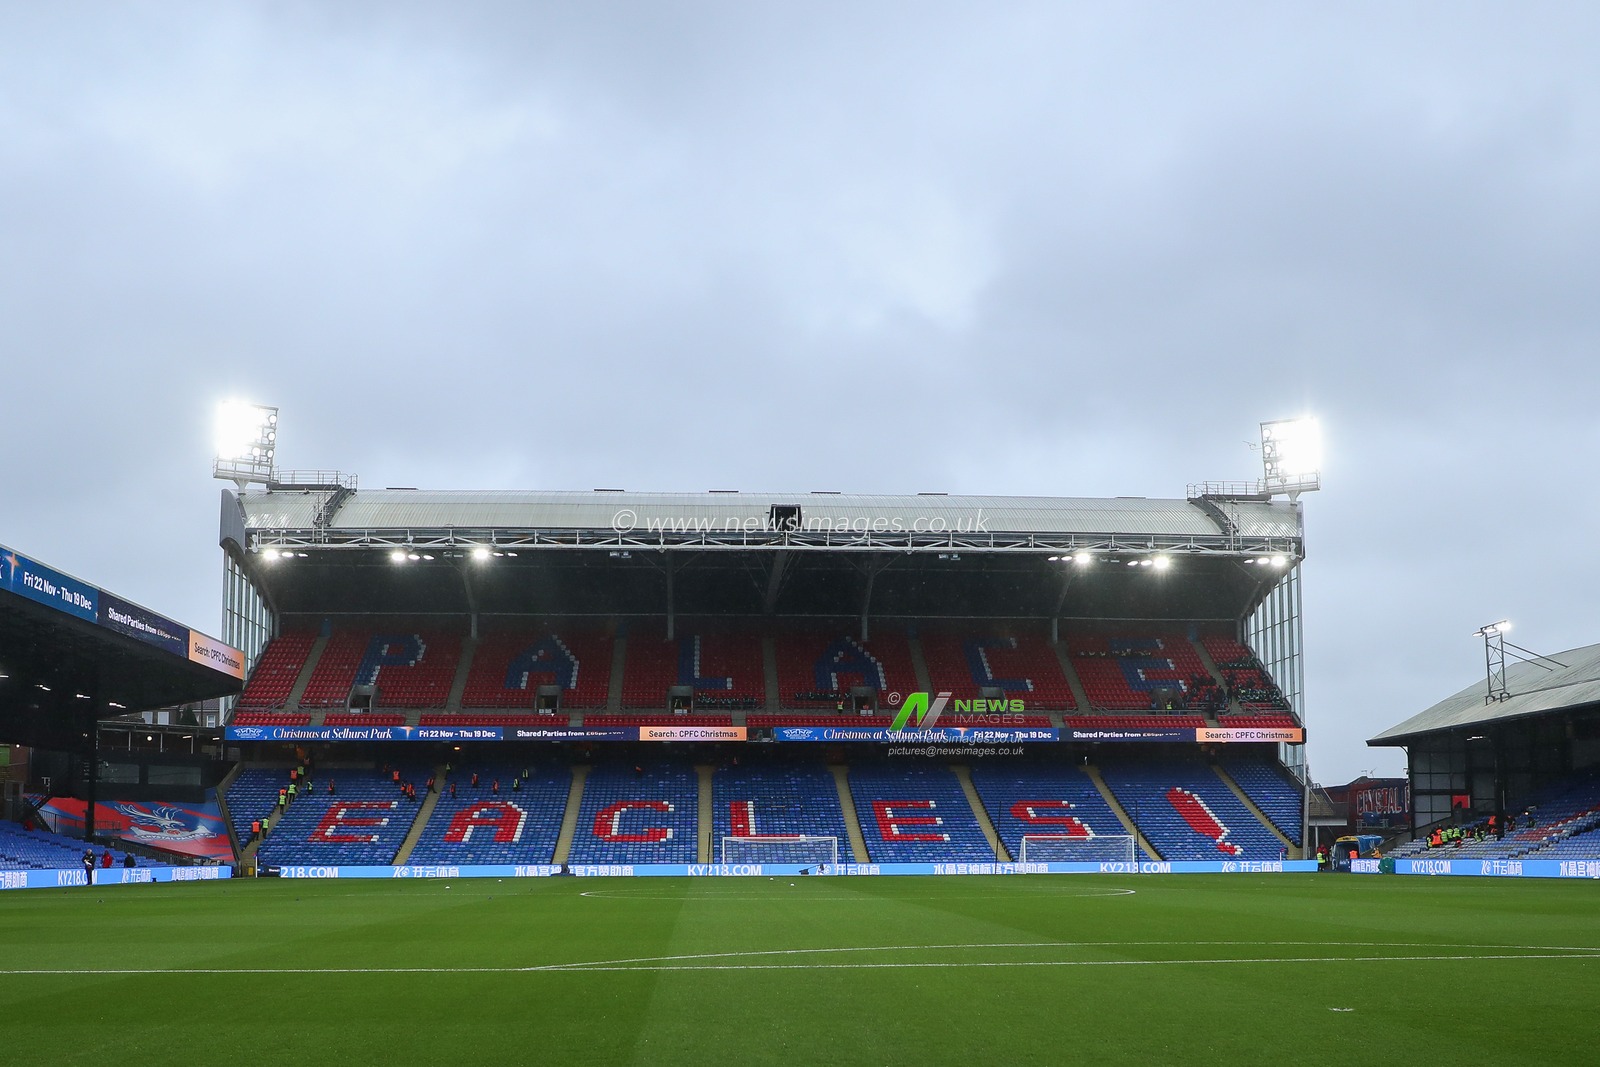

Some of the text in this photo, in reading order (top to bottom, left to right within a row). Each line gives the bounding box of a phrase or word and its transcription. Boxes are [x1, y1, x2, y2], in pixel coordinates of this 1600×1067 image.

[24, 571, 34, 587] Fri
[34, 576, 43, 591] 22
[43, 579, 56, 596] Nov
[61, 586, 73, 603] Thu
[73, 592, 80, 606] 19
[80, 595, 92, 610] Dec
[108, 607, 127, 625] Shared
[127, 615, 145, 630] Parties
[145, 623, 157, 635] from
[194, 642, 241, 670] Search: CPFC Christmas
[273, 728, 392, 739] Christmas at Selhurst Park
[419, 730, 429, 738] Fri
[429, 730, 439, 738] 22
[440, 730, 453, 738] Nov
[459, 730, 473, 738] Thu
[474, 730, 481, 738] 19
[482, 730, 496, 738] Dec
[649, 730, 738, 738] Search: CPFC Christmas
[824, 729, 871, 740] Christmas
[873, 729, 882, 740] at
[884, 729, 922, 740] Selhurst
[1205, 731, 1294, 739] Search: CPFC Christmas
[1357, 787, 1402, 815] CRYSTAL
[412, 866, 460, 878] 开云体育
[687, 865, 762, 876] KY218.COM
[1100, 862, 1171, 874] KY218.COM
[1239, 861, 1283, 873] 开云体育
[1411, 860, 1451, 873] KY218.COM
[57, 870, 98, 886] KY218.CM
